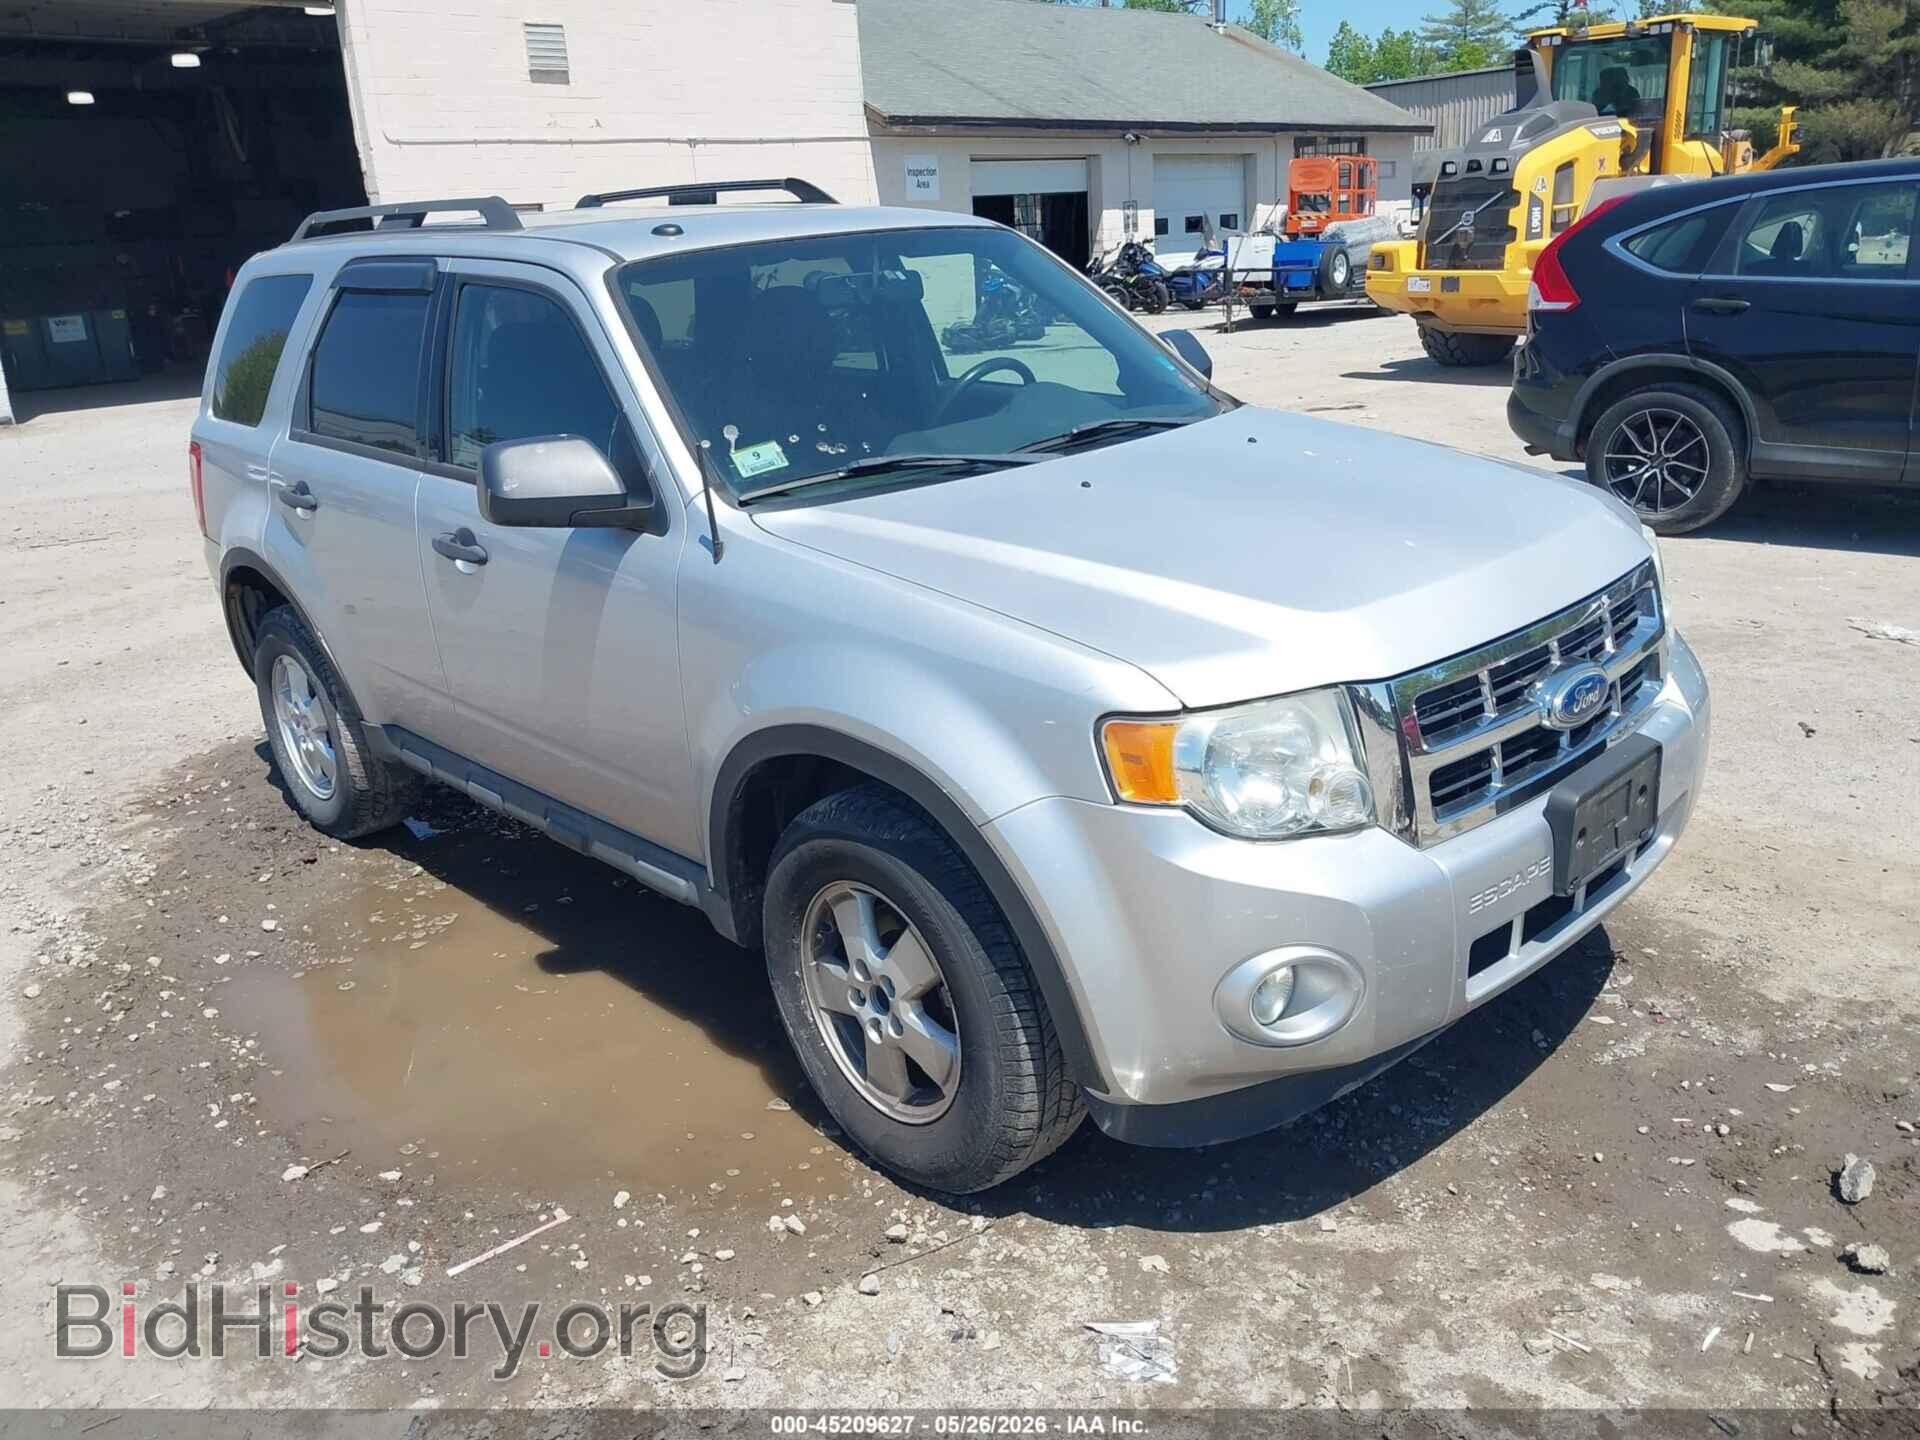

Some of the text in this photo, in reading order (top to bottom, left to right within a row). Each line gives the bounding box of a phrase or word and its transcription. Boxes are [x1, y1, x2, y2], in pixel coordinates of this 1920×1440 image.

[906, 167, 937, 178] Inspection
[916, 178, 930, 189] Area
[752, 451, 761, 461] 9
[1573, 681, 1600, 713] Ford
[1469, 856, 1551, 914] ESCAPE
